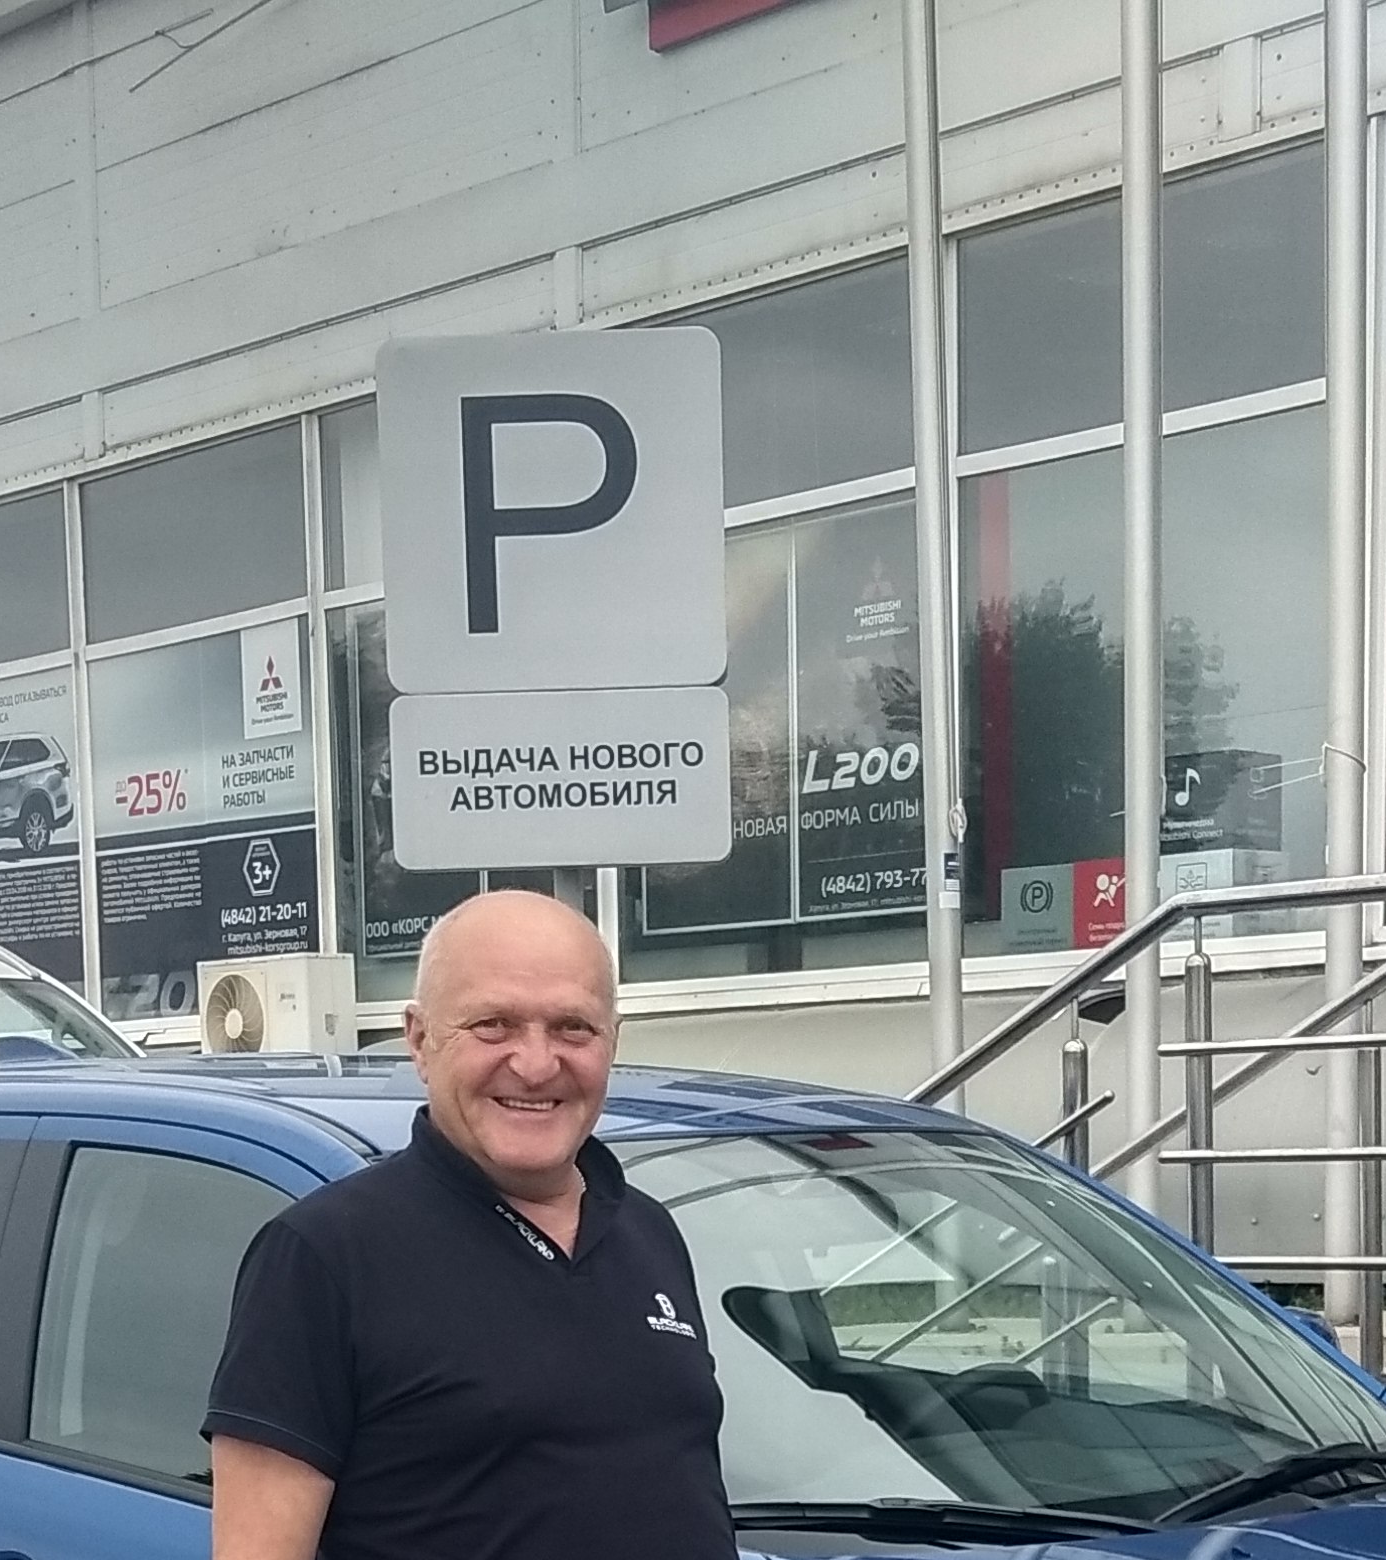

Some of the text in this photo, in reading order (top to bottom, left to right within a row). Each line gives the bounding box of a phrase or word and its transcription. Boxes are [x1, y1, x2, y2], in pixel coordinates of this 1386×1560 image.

[460, 392, 638, 634] P
[853, 599, 902, 618] MITSUBISHI
[859, 612, 896, 628] MOTORS
[14, 684, 68, 706] ОТКАЗЫВАТЬСЯ
[255, 691, 288, 705] MITSUBISHI
[260, 701, 285, 712] MOTORS
[222, 745, 295, 770] НА ЗАПЧАСТИ
[418, 740, 705, 780] ВЫДАЧА НОВОГО
[801, 742, 920, 794] L200
[222, 765, 295, 789] И СЕРВИСНЫЕ
[223, 790, 266, 809] РАБОТЫ
[449, 779, 678, 813] АВТОМОБИЛЯ
[733, 798, 919, 840] НОВАЯ ФОРМА СИЛЫ
[252, 861, 273, 885] 3+
[821, 871, 872, 898] (4842)
[221, 901, 307, 929] (4842) 21-20-11
[366, 920, 390, 938] ООО
[391, 916, 430, 935] «КОРС
